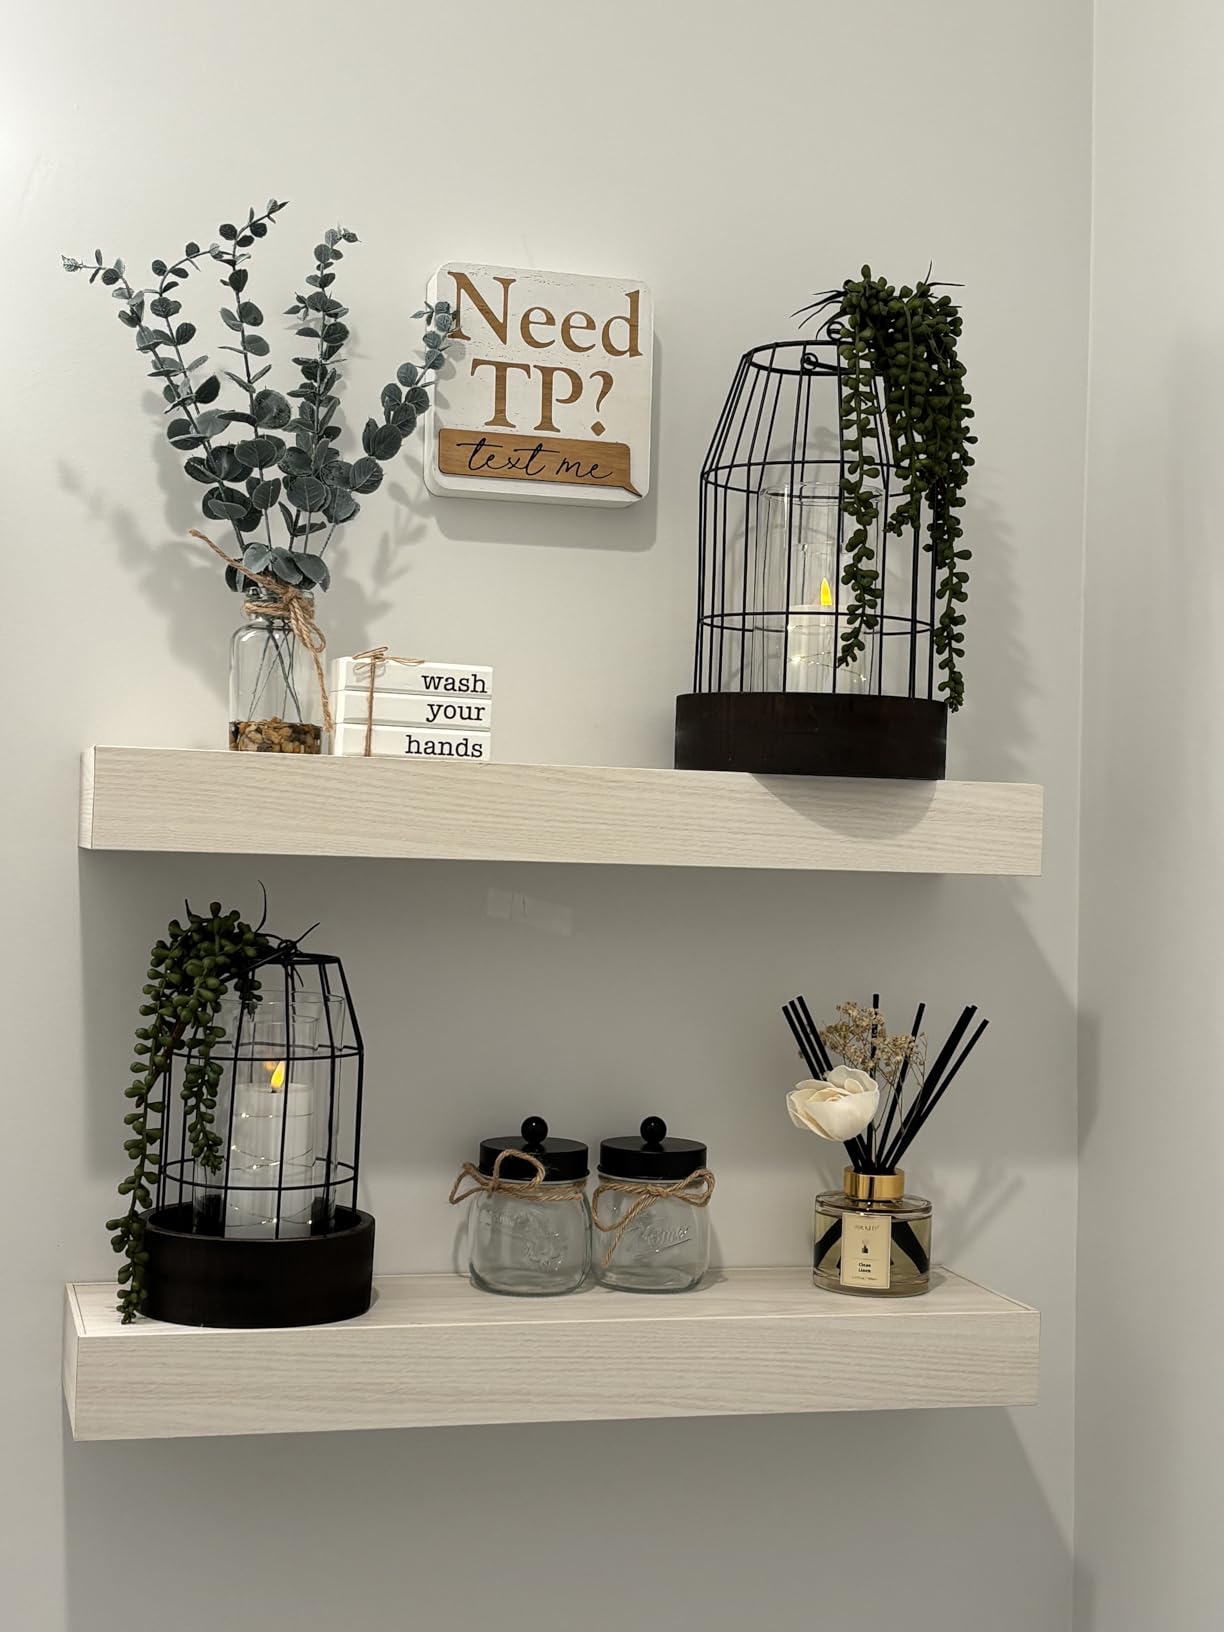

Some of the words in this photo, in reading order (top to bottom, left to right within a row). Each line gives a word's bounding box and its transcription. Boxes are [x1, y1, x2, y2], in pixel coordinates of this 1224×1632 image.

[447, 271, 643, 358] Need
[470, 358, 614, 437] TP?
[456, 437, 561, 476] text
[555, 457, 614, 479] me
[421, 673, 488, 694] wash
[425, 703, 486, 723] your
[405, 734, 483, 758] hands
